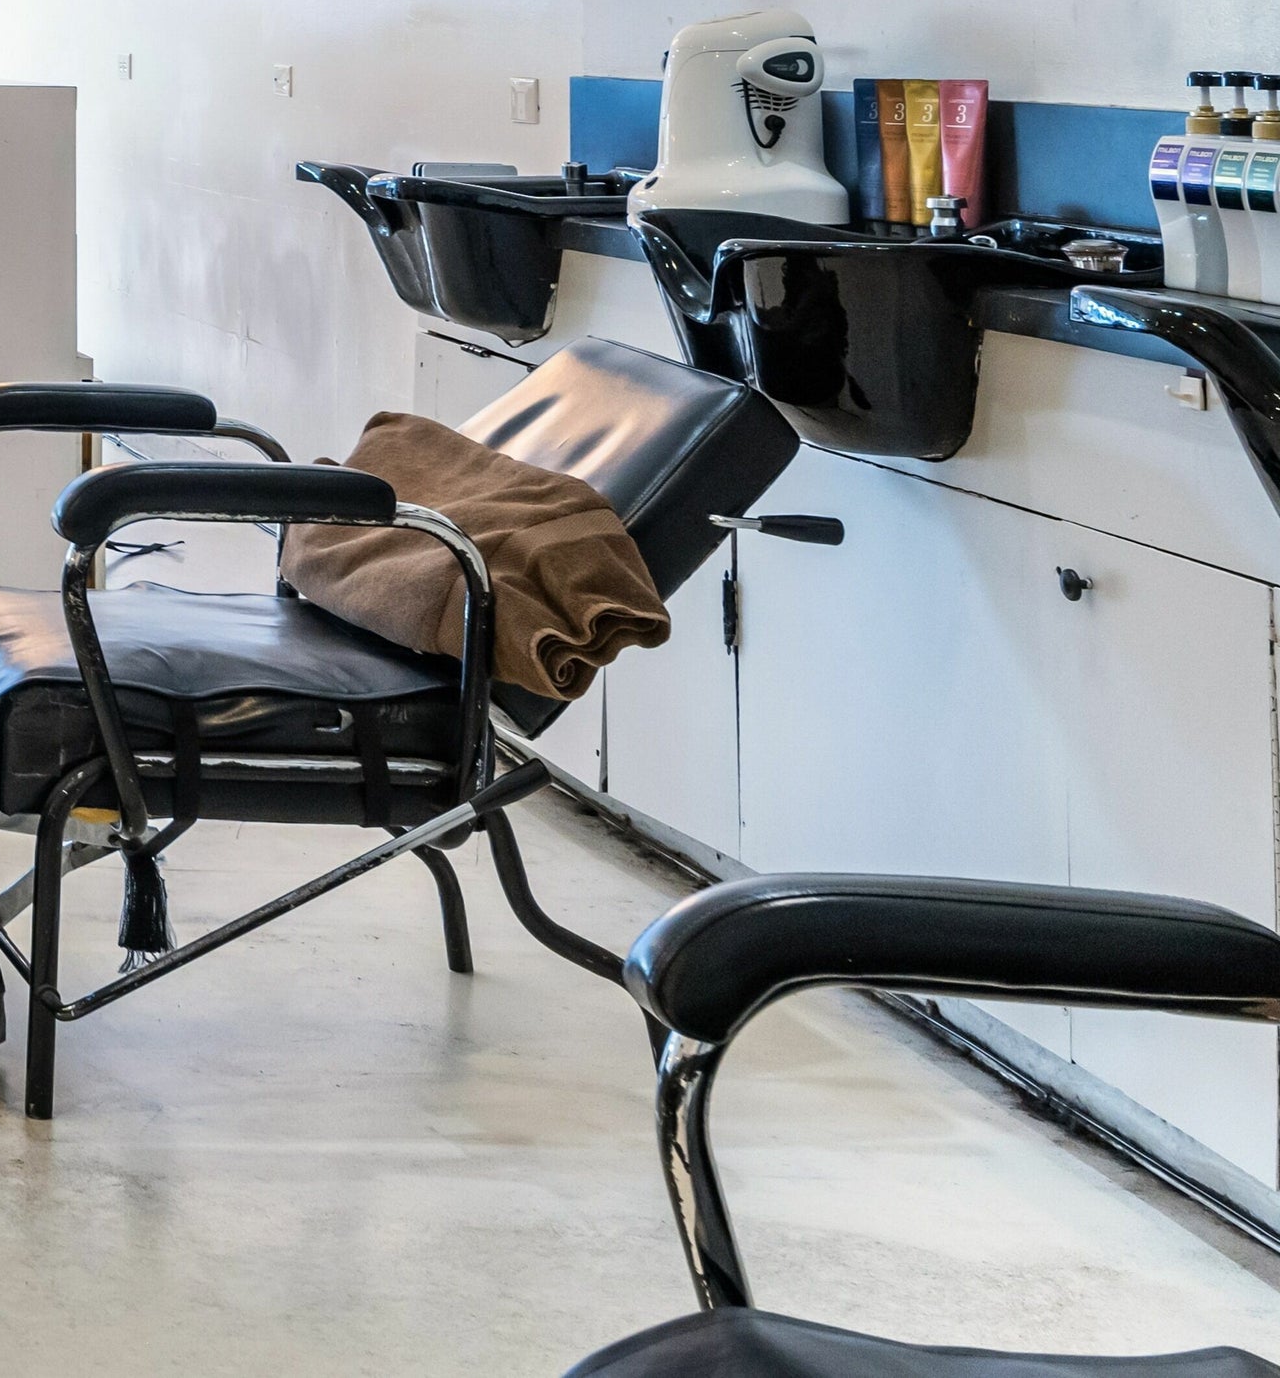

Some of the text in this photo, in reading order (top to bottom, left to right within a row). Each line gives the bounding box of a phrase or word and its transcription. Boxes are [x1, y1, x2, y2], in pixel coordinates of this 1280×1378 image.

[868, 101, 878, 120] 3
[894, 102, 905, 121] 3
[921, 103, 933, 123] 3
[955, 104, 967, 124] 3
